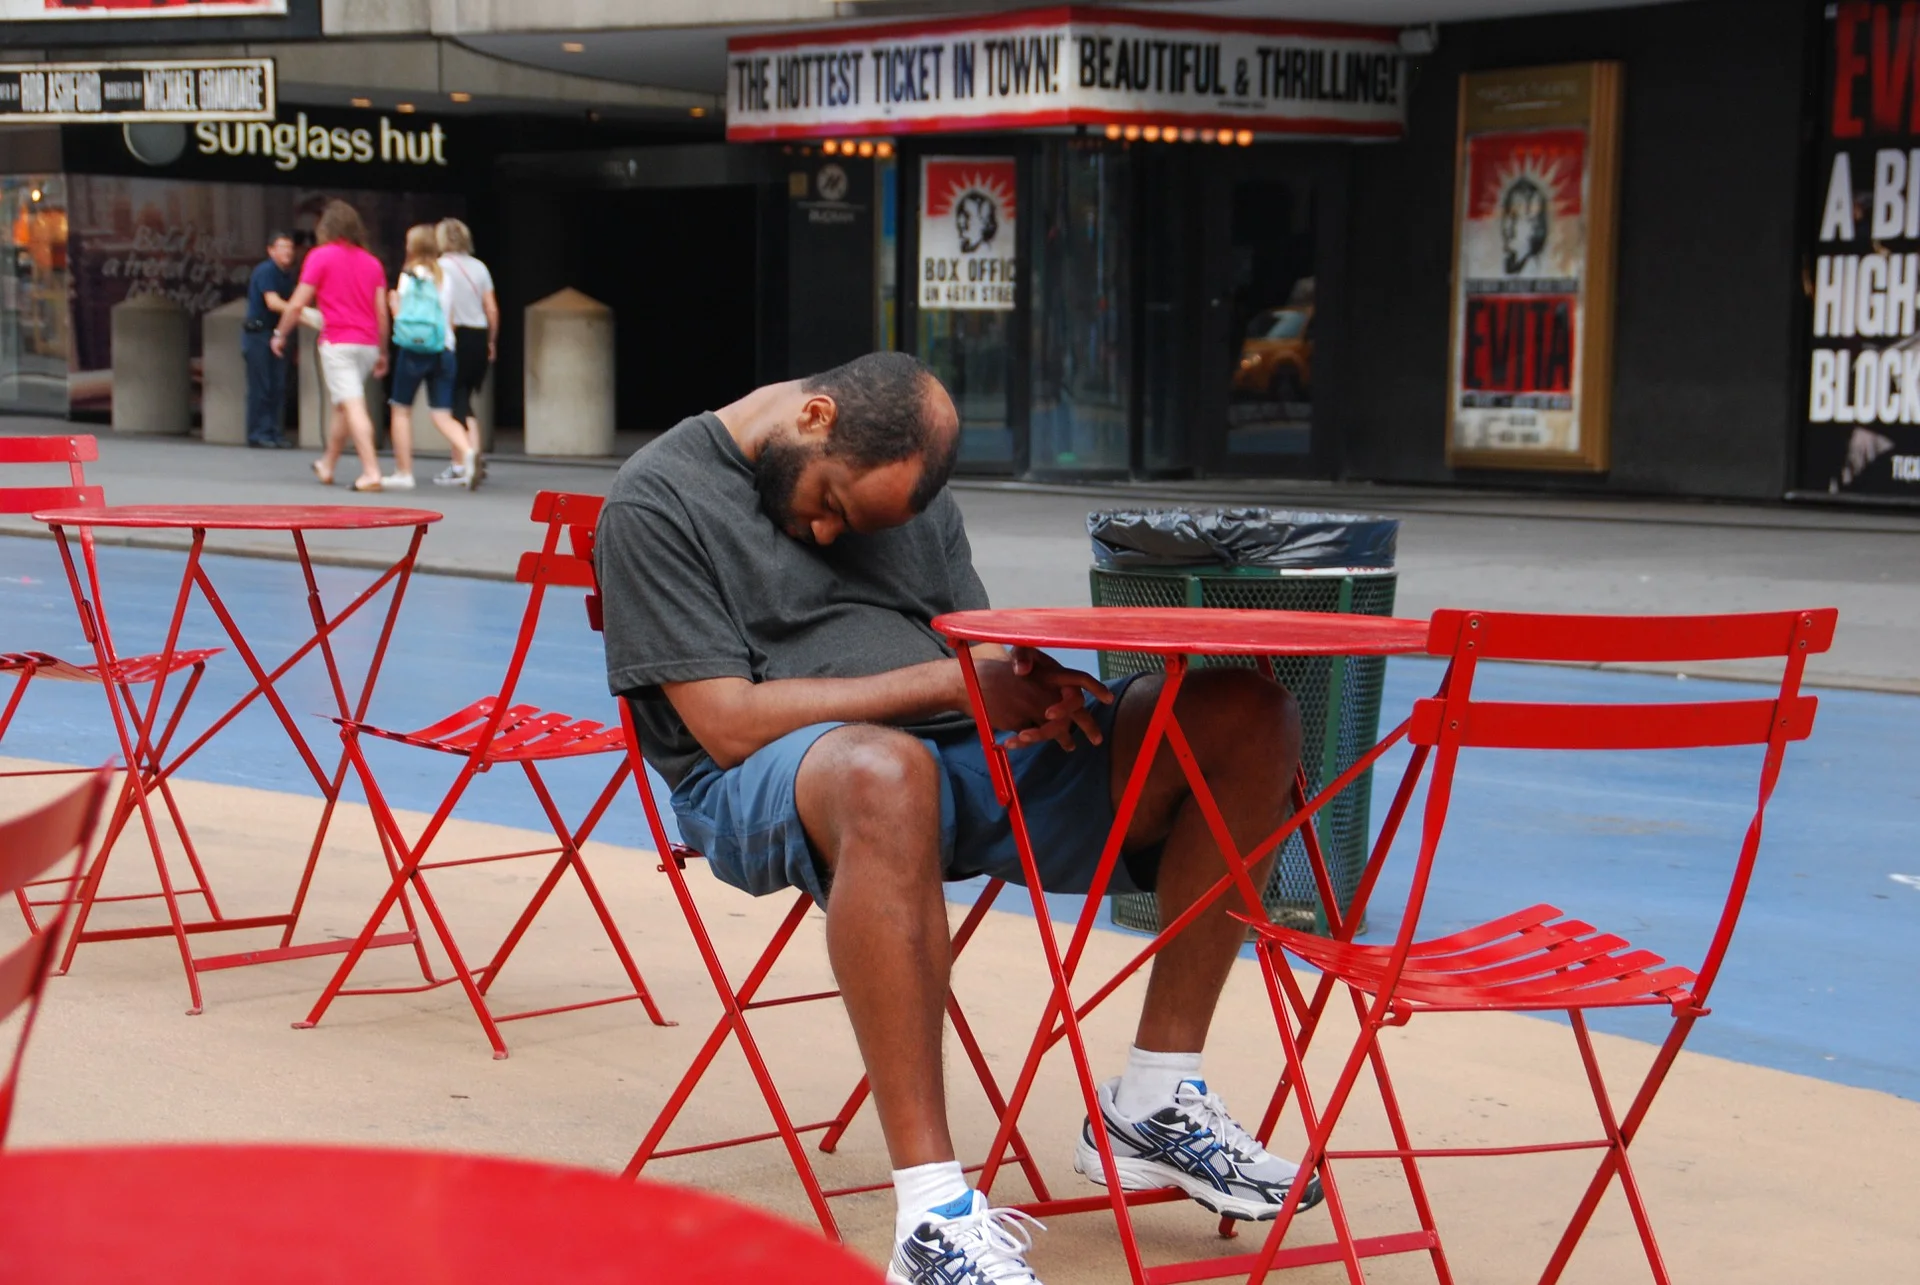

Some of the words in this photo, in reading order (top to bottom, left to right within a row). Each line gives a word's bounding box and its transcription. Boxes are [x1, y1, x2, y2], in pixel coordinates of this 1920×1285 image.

[732, 57, 769, 112] THE
[776, 52, 863, 110] HOTTEST
[873, 45, 943, 104] TICKET
[954, 40, 975, 98] IN
[1234, 57, 1249, 97] &
[1256, 46, 1397, 105] THRILLING!
[195, 111, 374, 171] sunglass
[380, 115, 447, 165] hut
[1819, 151, 1855, 241] A
[925, 257, 960, 282] BOX
[1466, 299, 1570, 390] EVITA
[1809, 347, 1920, 424] BLOCK
